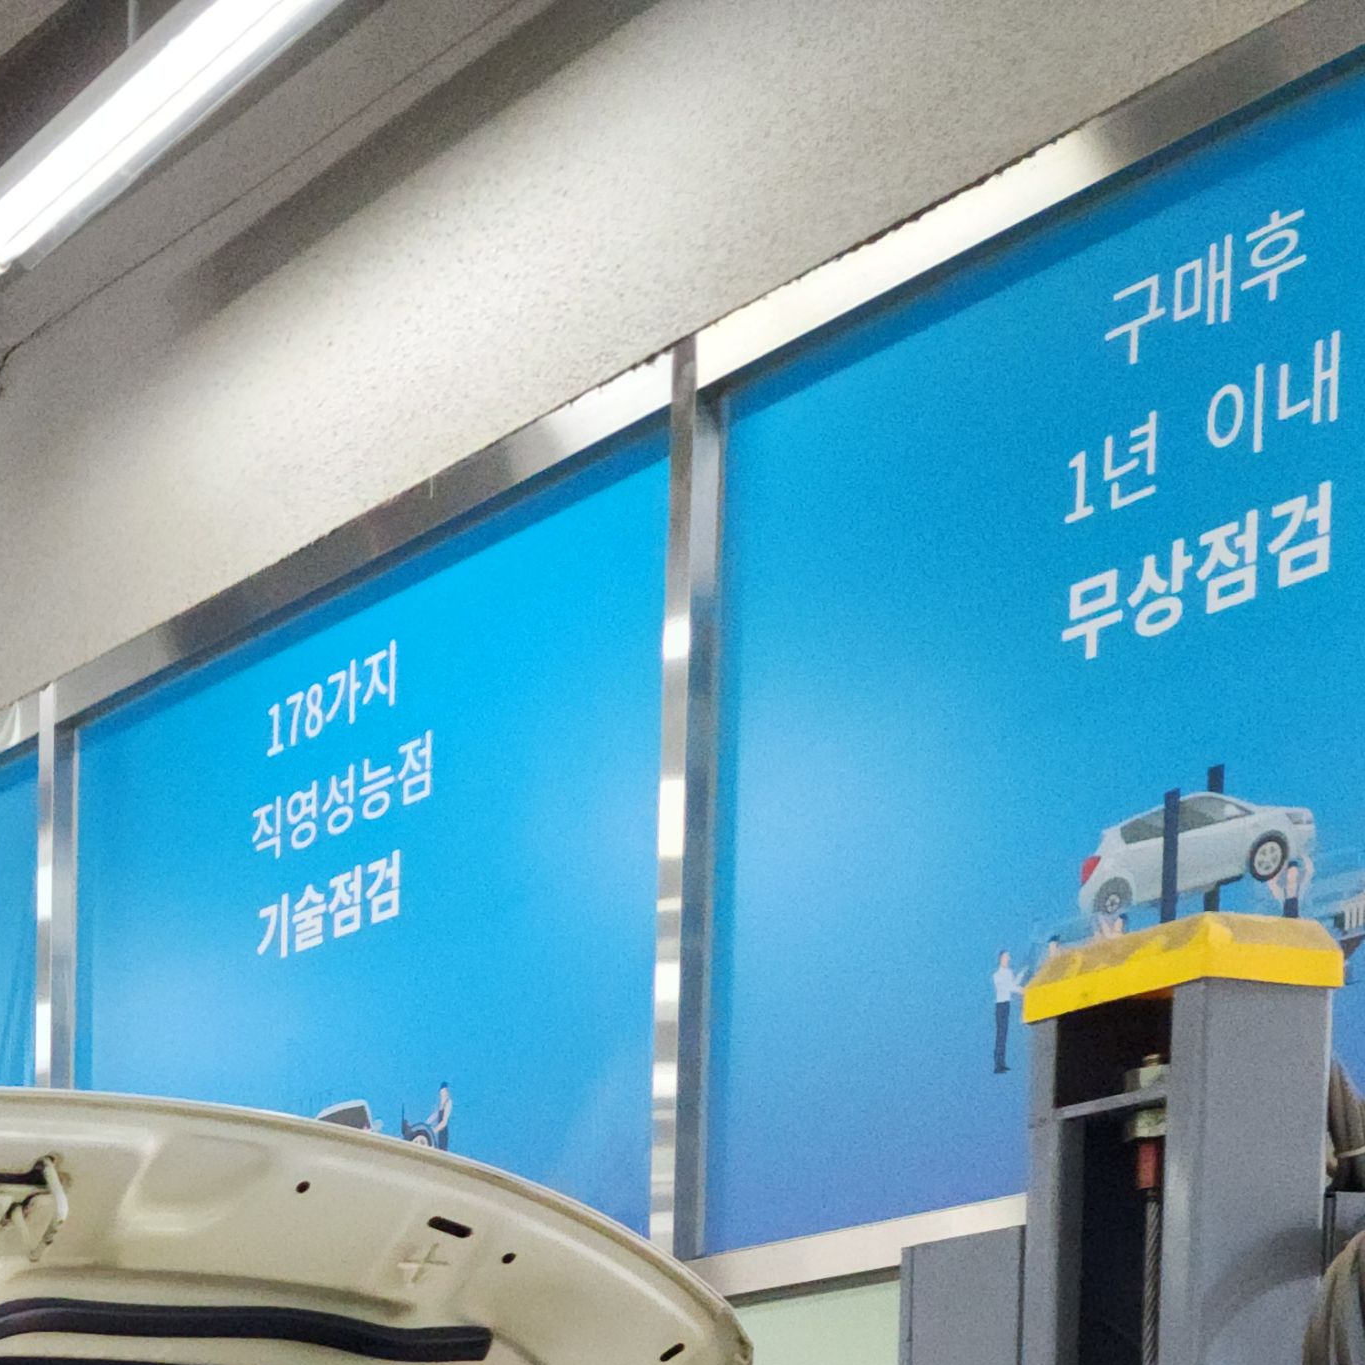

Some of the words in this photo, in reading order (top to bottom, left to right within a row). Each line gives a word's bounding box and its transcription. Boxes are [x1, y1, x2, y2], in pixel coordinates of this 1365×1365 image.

[1105, 208, 1307, 364] 구매후
[1064, 411, 1158, 523] 1년
[1206, 330, 1342, 453] 이내
[1061, 481, 1333, 660] 무상점검
[267, 640, 398, 757] 178가지
[251, 730, 434, 860] 직영성능점
[255, 850, 401, 959] 기술점검
